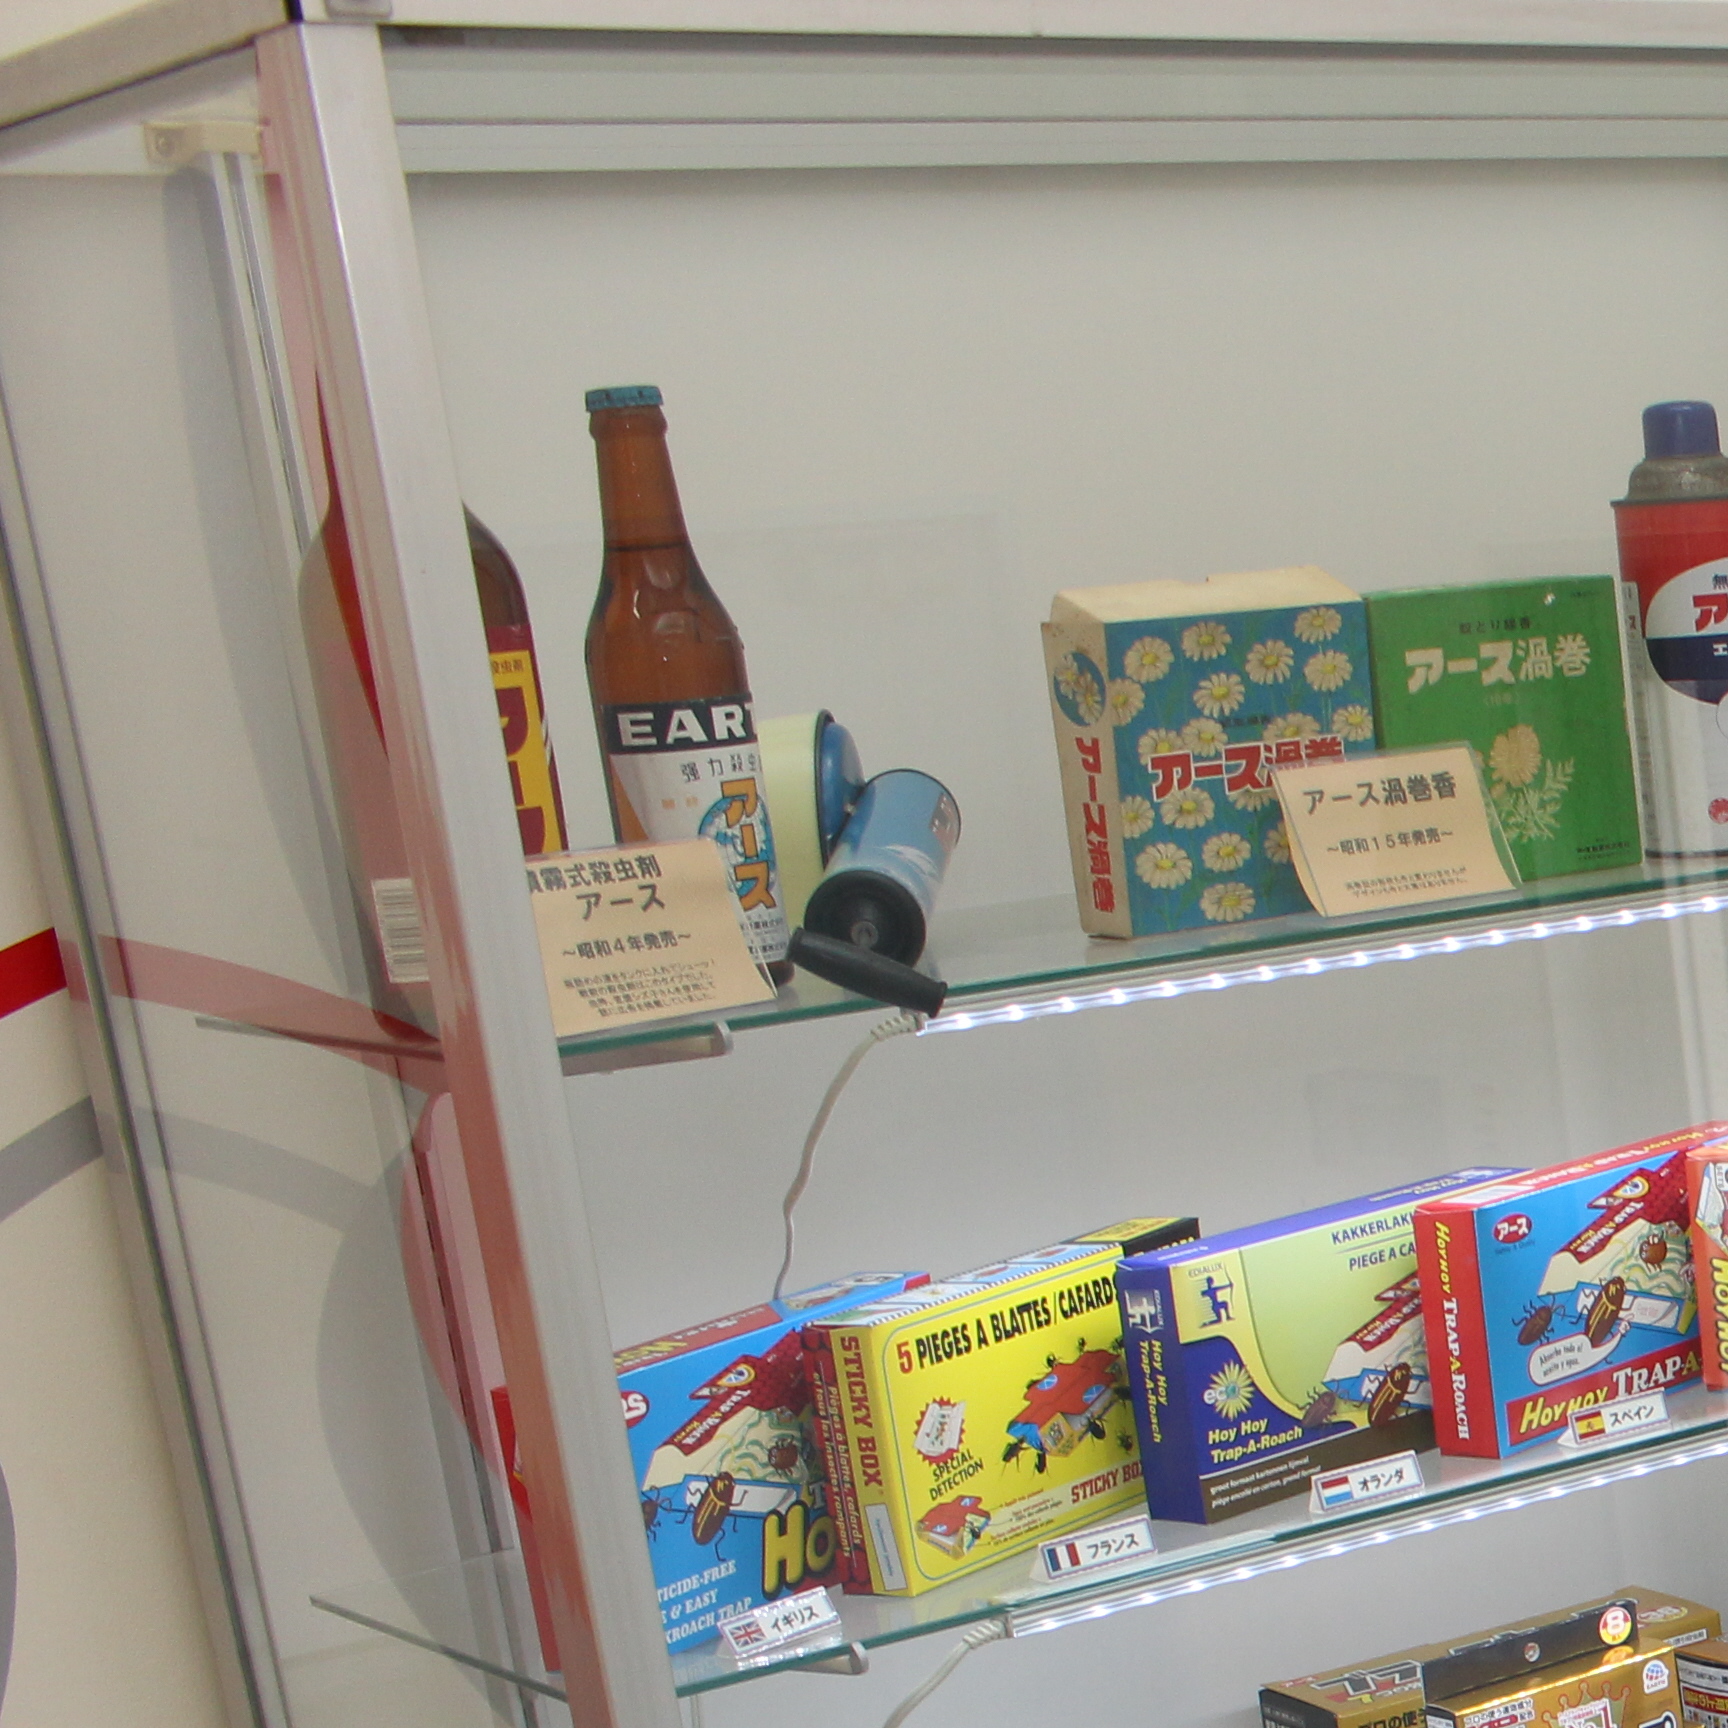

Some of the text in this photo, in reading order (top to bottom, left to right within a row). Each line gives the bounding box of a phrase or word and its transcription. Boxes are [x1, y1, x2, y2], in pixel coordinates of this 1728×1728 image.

[1403, 635, 1592, 695] アース渦巻
[617, 704, 758, 750] EAR
[1301, 770, 1459, 815] アース渦巻香
[1074, 736, 1115, 914] アース渦巻
[720, 777, 778, 912] アース
[575, 883, 666, 921] アース
[1496, 1215, 1530, 1242] アース
[1348, 1250, 1387, 1273] PIEGE
[896, 1317, 990, 1374] 5 PIEGES A
[840, 1335, 883, 1488] STICKY BOX
[1608, 1403, 1655, 1428] スペイン
[1208, 1417, 1269, 1446] Hoy Hoy
[1210, 1426, 1304, 1465] Trap-A-Roach
[928, 1458, 985, 1501] DETECTION
[932, 1449, 975, 1484] SPECIAL
[1070, 1466, 1120, 1505] STICKY
[1358, 1469, 1405, 1492] オランダ
[1086, 1531, 1139, 1561] フランス
[685, 1588, 719, 1614] EASY
[769, 1603, 820, 1632] イギリス
